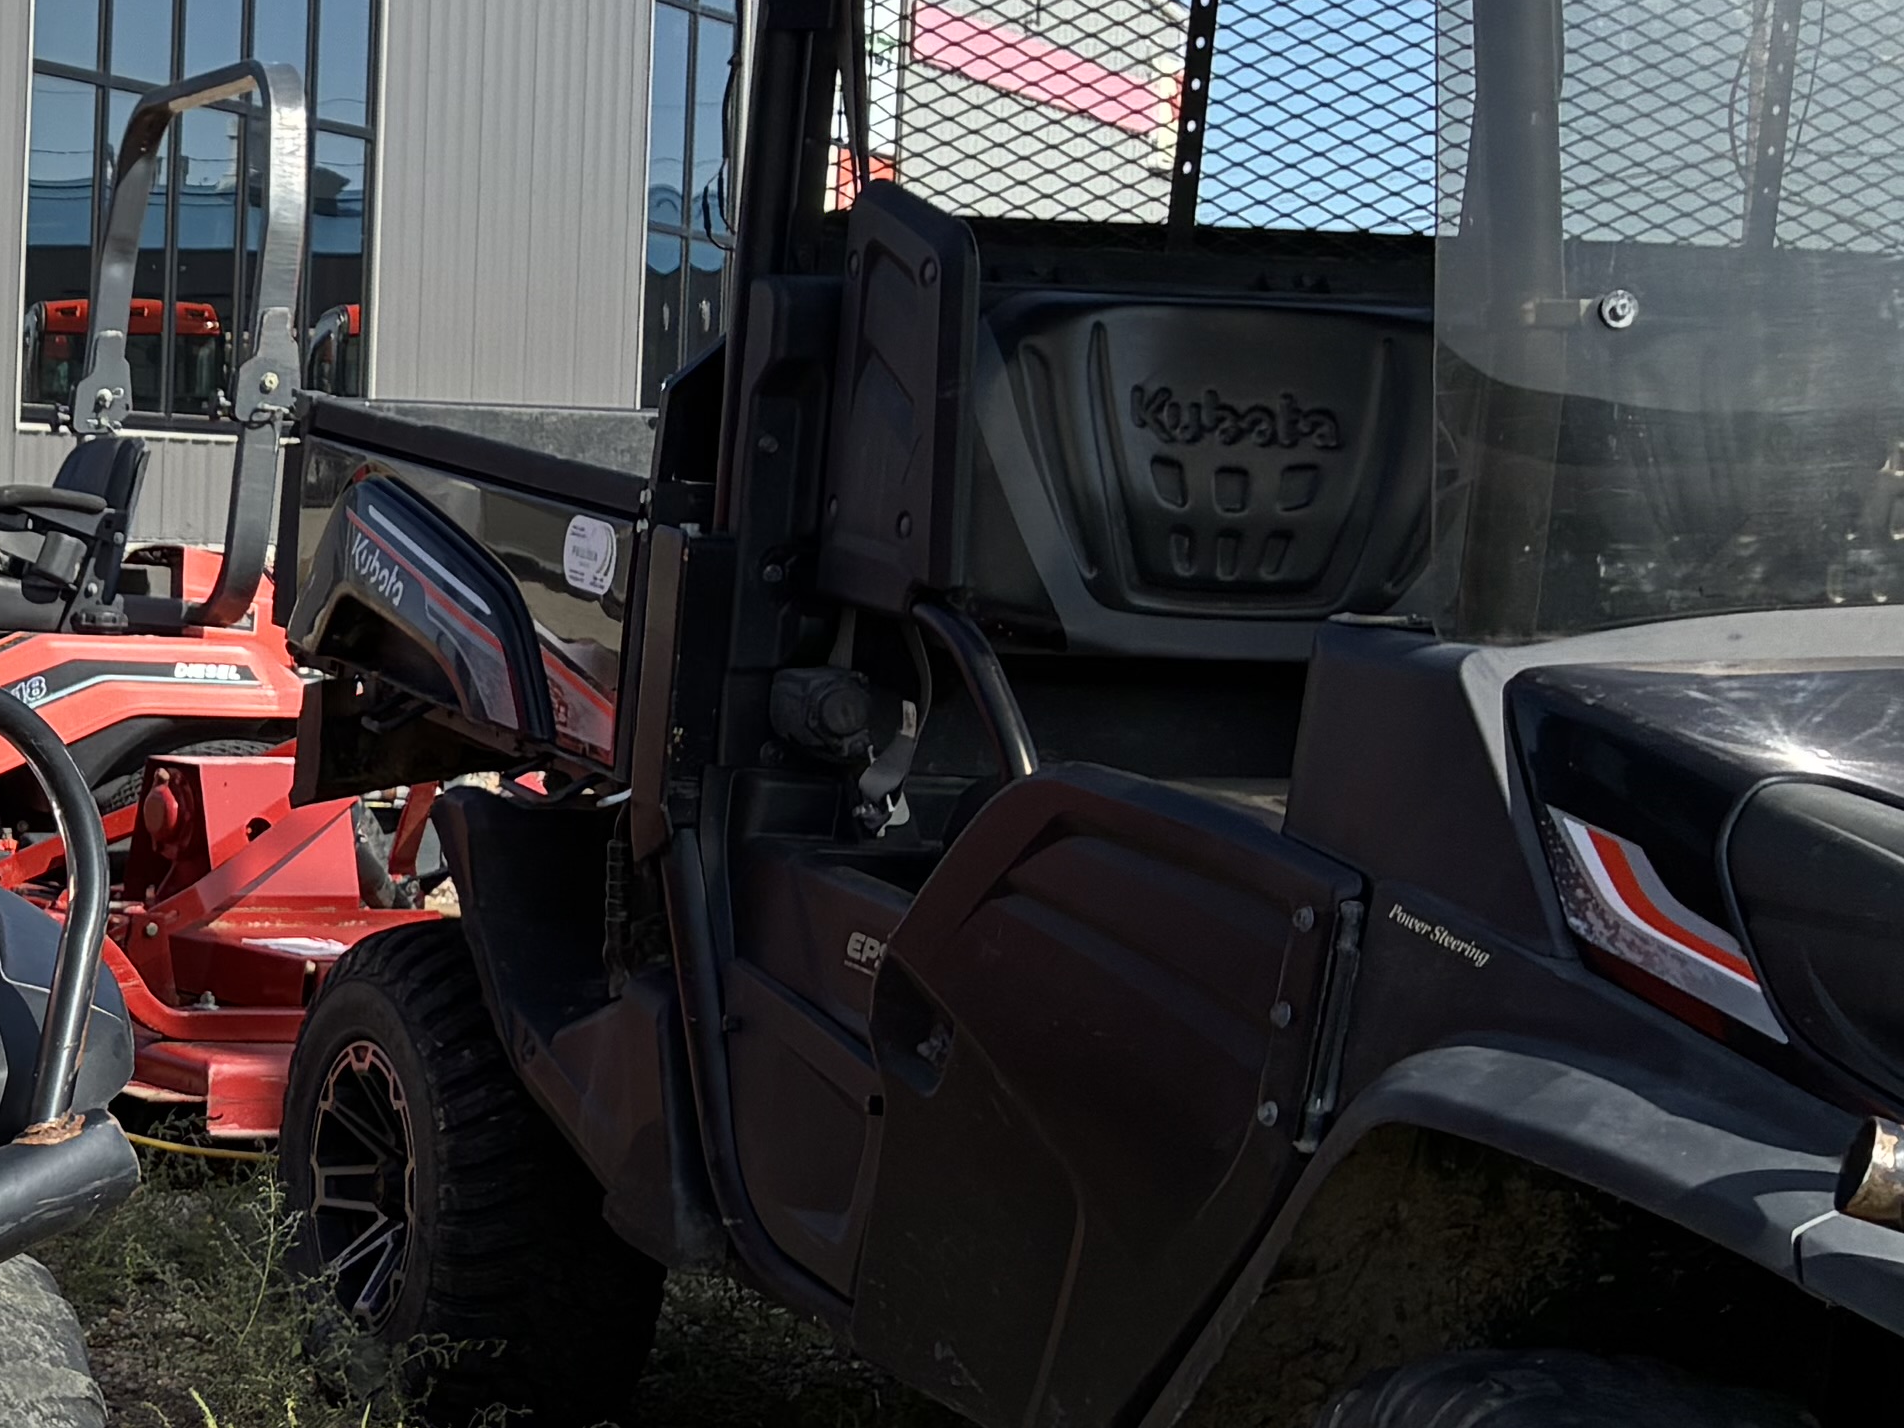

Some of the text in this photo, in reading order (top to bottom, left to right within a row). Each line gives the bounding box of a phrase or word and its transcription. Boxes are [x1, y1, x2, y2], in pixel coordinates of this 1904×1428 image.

[1130, 384, 1346, 450] Kubota
[351, 532, 405, 607] Kubota
[173, 661, 241, 681] DIESEL
[1388, 902, 1491, 968] Power Steering
